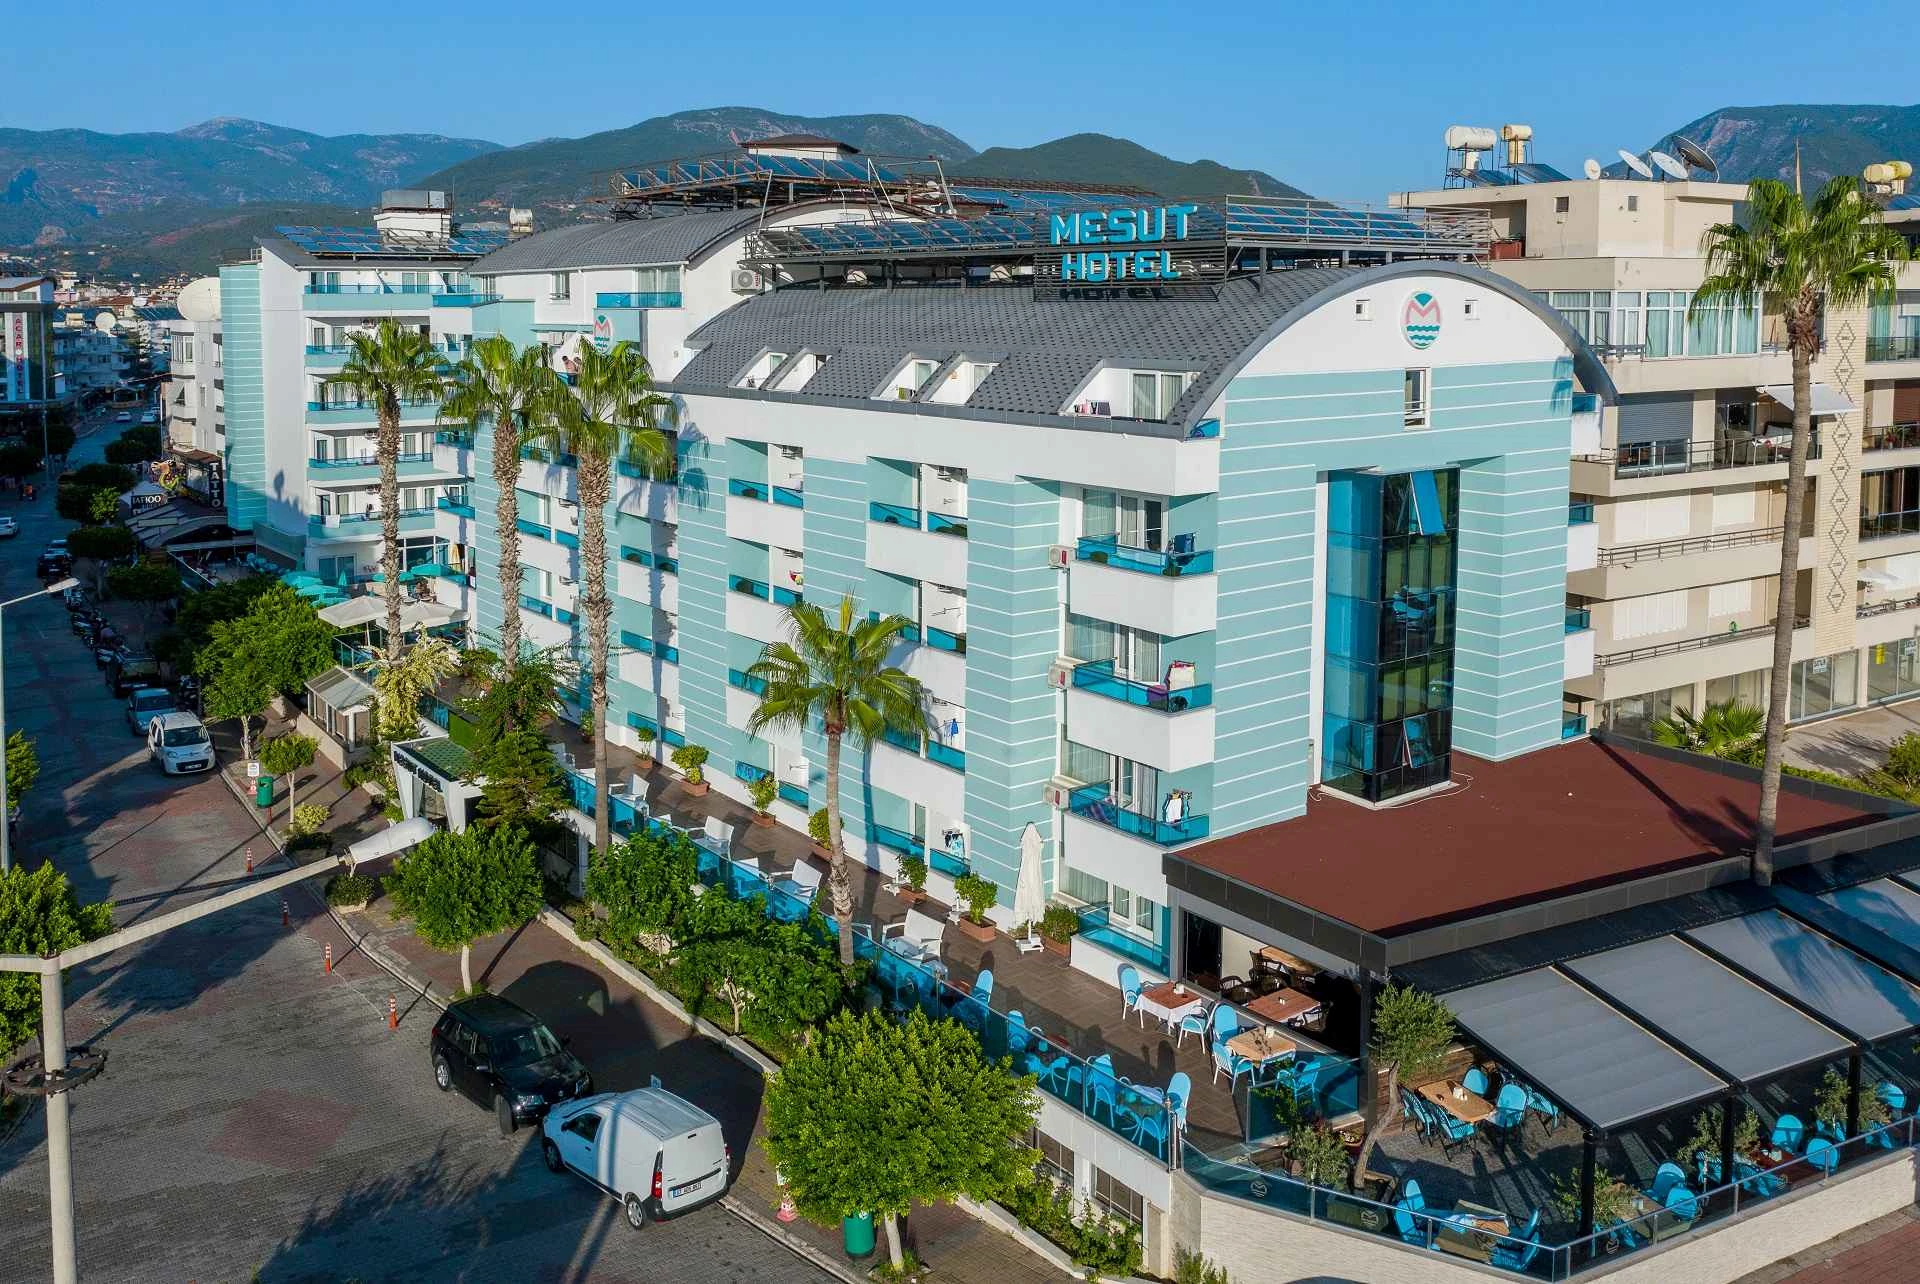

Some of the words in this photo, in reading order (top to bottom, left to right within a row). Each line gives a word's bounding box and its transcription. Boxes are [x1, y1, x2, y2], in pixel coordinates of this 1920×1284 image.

[1050, 205, 1198, 245] MESUT
[1060, 249, 1181, 281] HOTEL
[132, 495, 161, 504] TATTOO
[210, 462, 221, 507] TATTO
